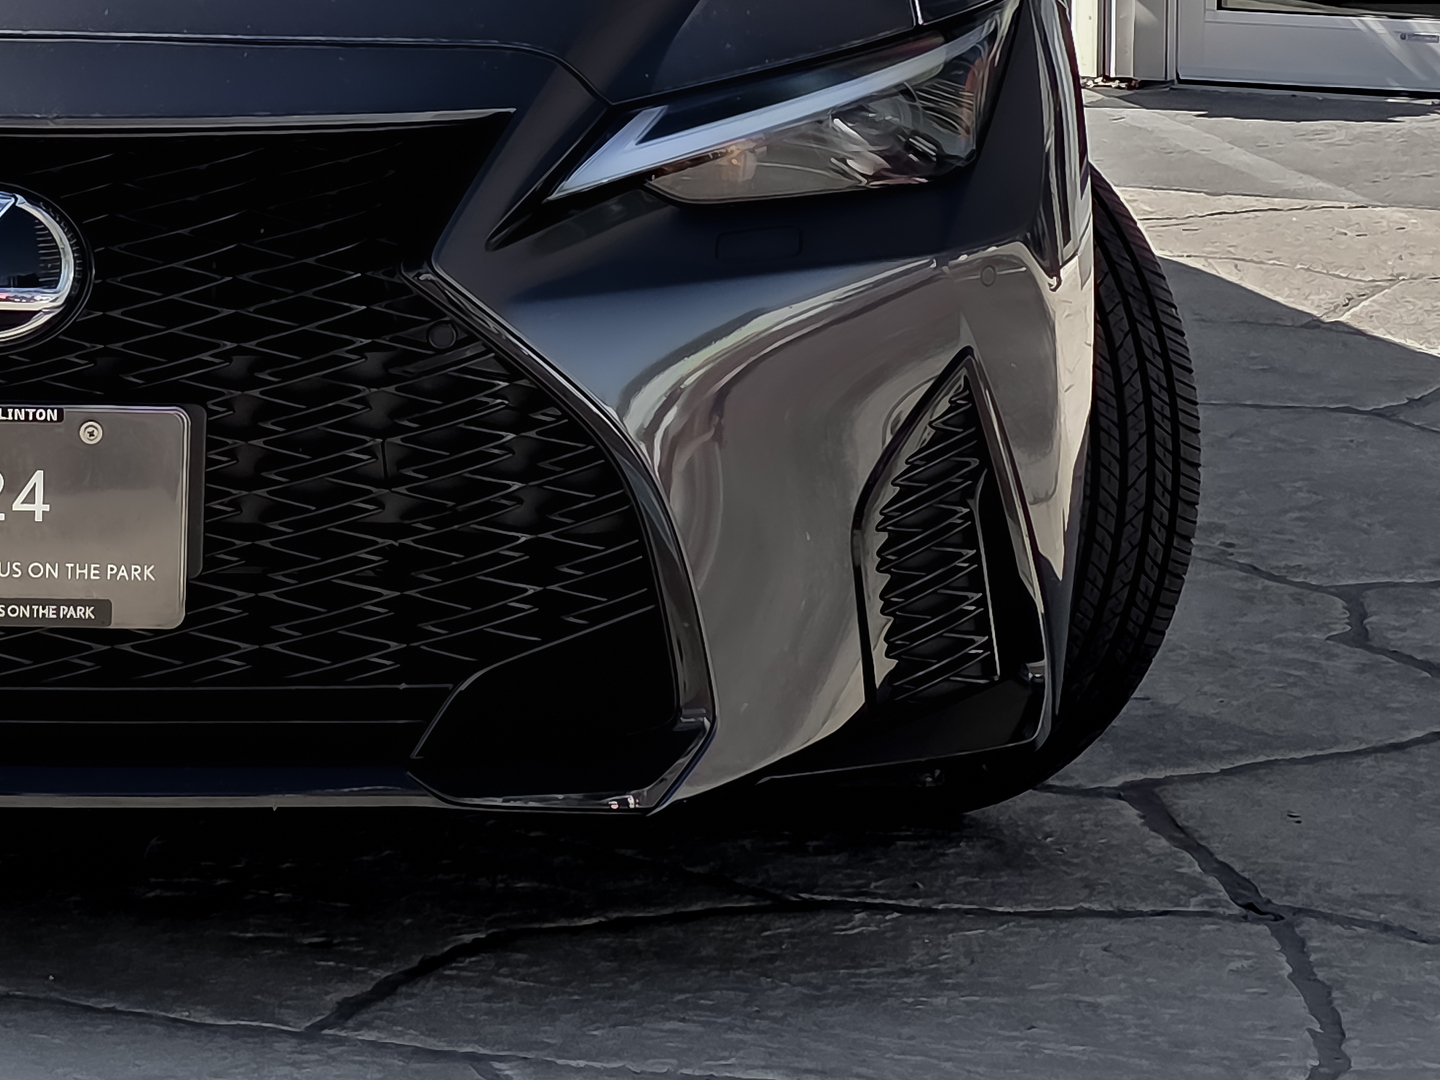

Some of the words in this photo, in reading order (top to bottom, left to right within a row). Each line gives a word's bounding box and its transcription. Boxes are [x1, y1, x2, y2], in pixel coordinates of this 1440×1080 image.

[27, 562, 59, 579] ON
[65, 563, 101, 580] THE
[107, 564, 156, 582] PARK
[59, 606, 96, 620] PARK
